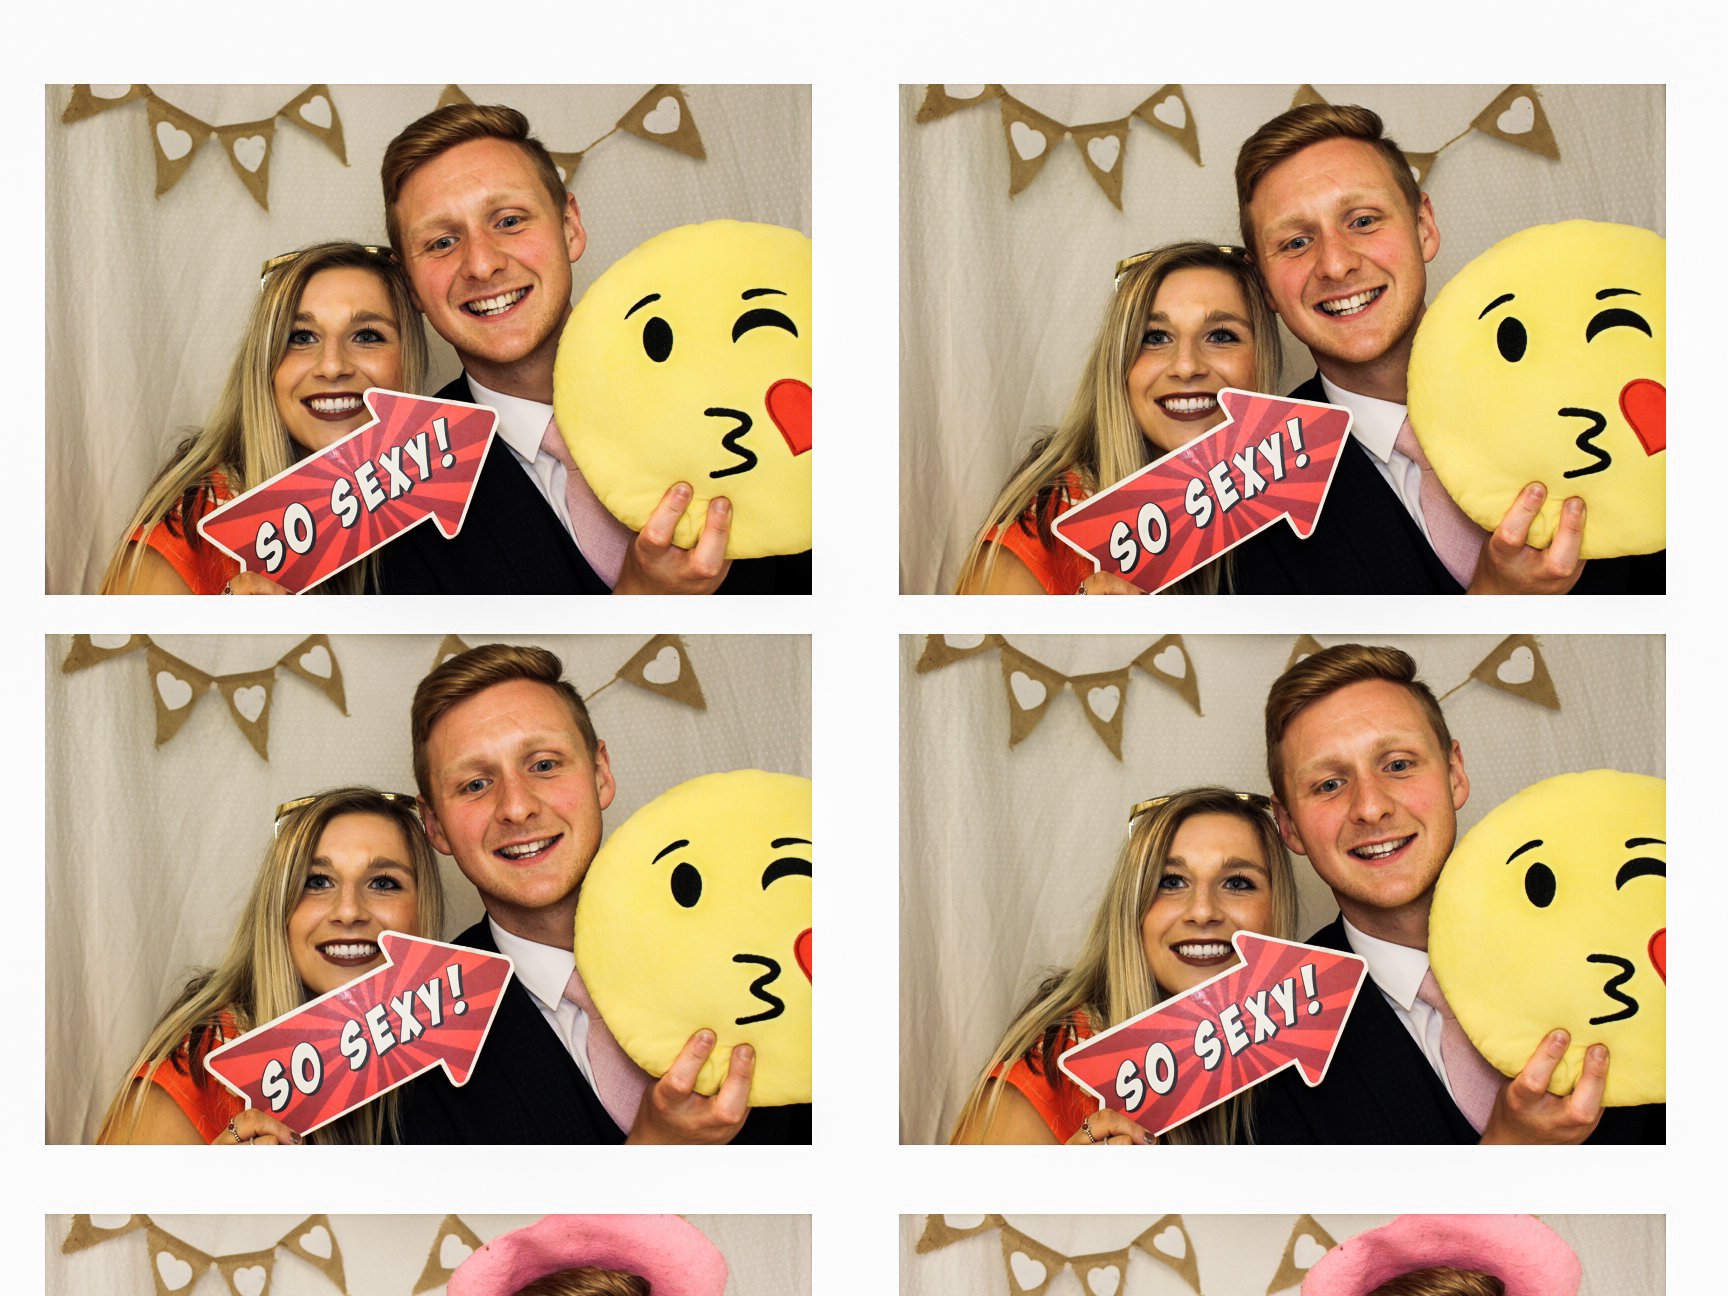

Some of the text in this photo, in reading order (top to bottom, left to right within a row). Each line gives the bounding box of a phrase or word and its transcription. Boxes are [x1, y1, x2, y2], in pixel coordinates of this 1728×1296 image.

[254, 416, 456, 575] SO SEXY!
[1108, 416, 1310, 575] SO SEXY!
[261, 963, 469, 1113] SO SEXY!
[1115, 963, 1323, 1113] SO SEXY!
